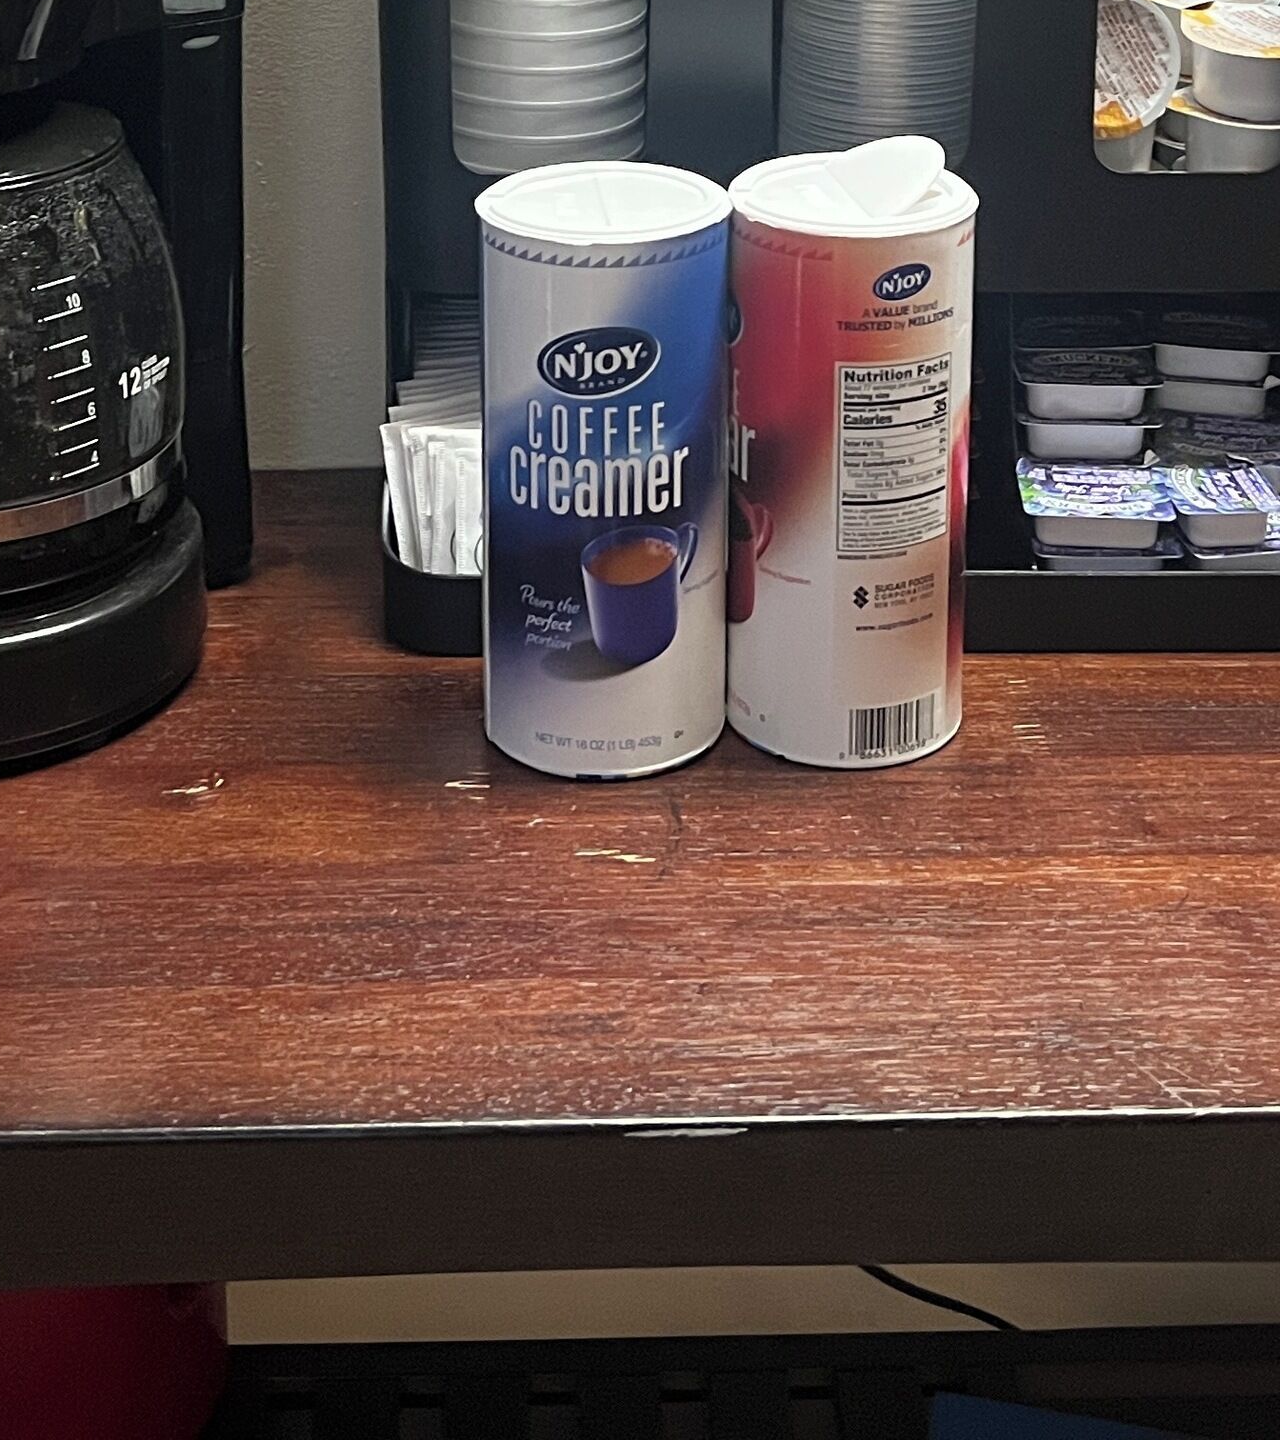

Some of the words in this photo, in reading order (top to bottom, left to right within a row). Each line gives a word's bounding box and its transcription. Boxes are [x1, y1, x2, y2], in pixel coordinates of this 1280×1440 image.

[66, 292, 81, 309] 10
[81, 349, 91, 363] 8
[844, 370, 913, 383] Nutrition
[917, 360, 949, 377] Facts
[119, 366, 142, 399] 12
[87, 402, 96, 416] 6
[528, 400, 665, 456] COFFEE
[844, 414, 893, 425] Calories
[520, 584, 555, 610] Pours
[556, 597, 581, 615] the
[525, 612, 572, 632] perfect
[525, 632, 572, 651] portion
[535, 731, 554, 744] NET
[555, 737, 573, 747] WT
[576, 739, 587, 750] 16
[589, 739, 605, 750] OZ
